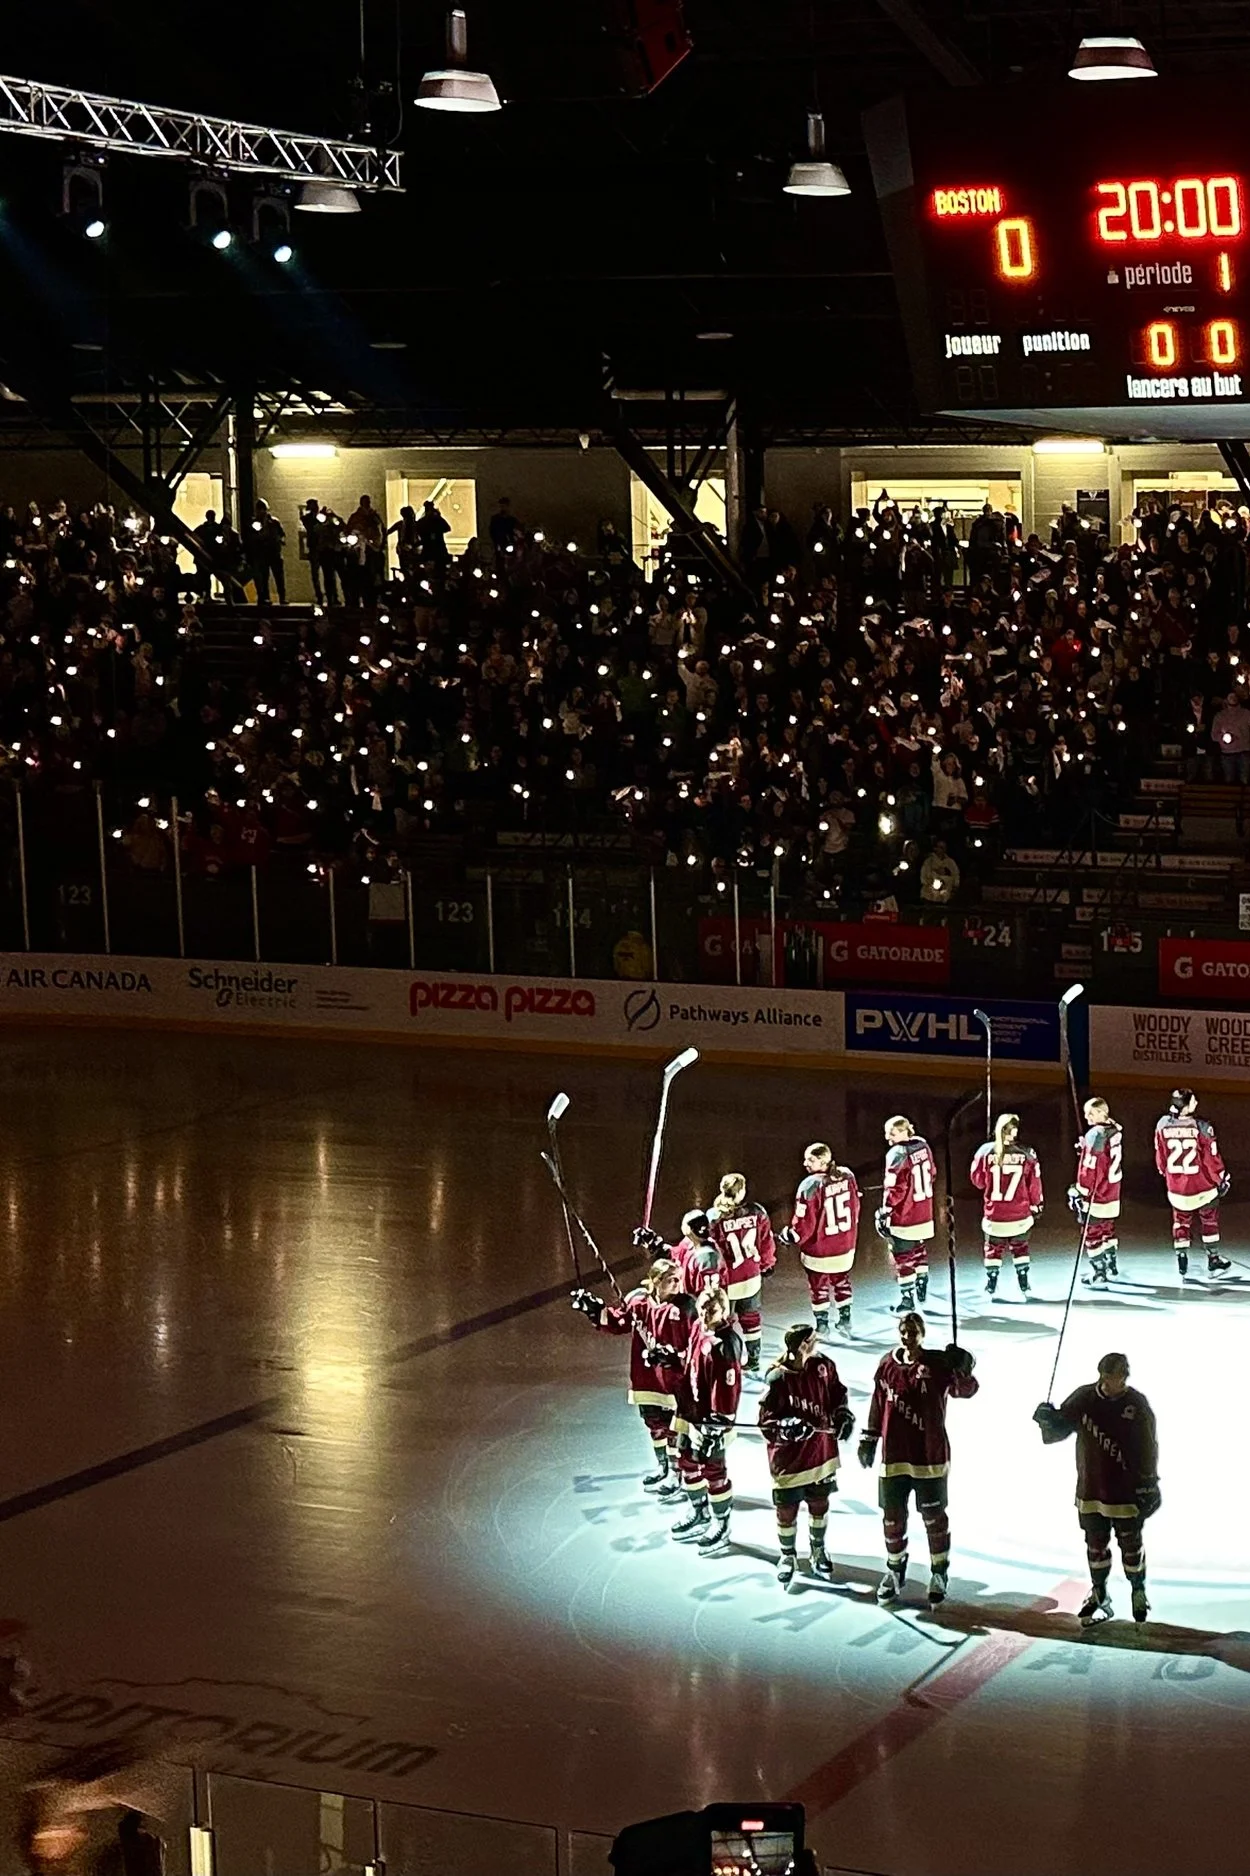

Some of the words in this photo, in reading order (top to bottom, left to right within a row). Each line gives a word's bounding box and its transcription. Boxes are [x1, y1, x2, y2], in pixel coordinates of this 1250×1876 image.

[935, 187, 1001, 216] BOSTON
[1098, 177, 1241, 241] 20:00
[998, 219, 1032, 277] 0
[1125, 261, 1193, 290] période
[1220, 252, 1231, 291] 1
[945, 334, 1001, 358] joueur
[1022, 331, 1090, 356] punition
[1150, 322, 1175, 366] 0
[1210, 320, 1236, 363] 0
[1127, 374, 1187, 398] lancers
[1191, 377, 1212, 397] au
[1214, 372, 1242, 397] but
[434, 901, 474, 923] 123
[856, 946, 945, 963] GATORADE
[6, 968, 48, 989] AIR
[52, 969, 151, 992] CANADA
[188, 968, 298, 994] Schneider
[236, 993, 297, 1009] Electric
[410, 982, 498, 1017] pizza
[505, 986, 595, 1022] pizza
[669, 1005, 749, 1026] Pathways
[754, 1008, 823, 1027] Alliance
[855, 1008, 982, 1043] PWHL
[1133, 1013, 1191, 1033] WOODY
[1135, 1033, 1190, 1051] CREEK
[1133, 1050, 1192, 1063] DISTILLERS
[1167, 1138, 1200, 1175] 22
[989, 1164, 1024, 1202] 17
[722, 1215, 758, 1232] DEMPSEY
[823, 1192, 852, 1236] 15
[727, 1228, 761, 1270] 14
